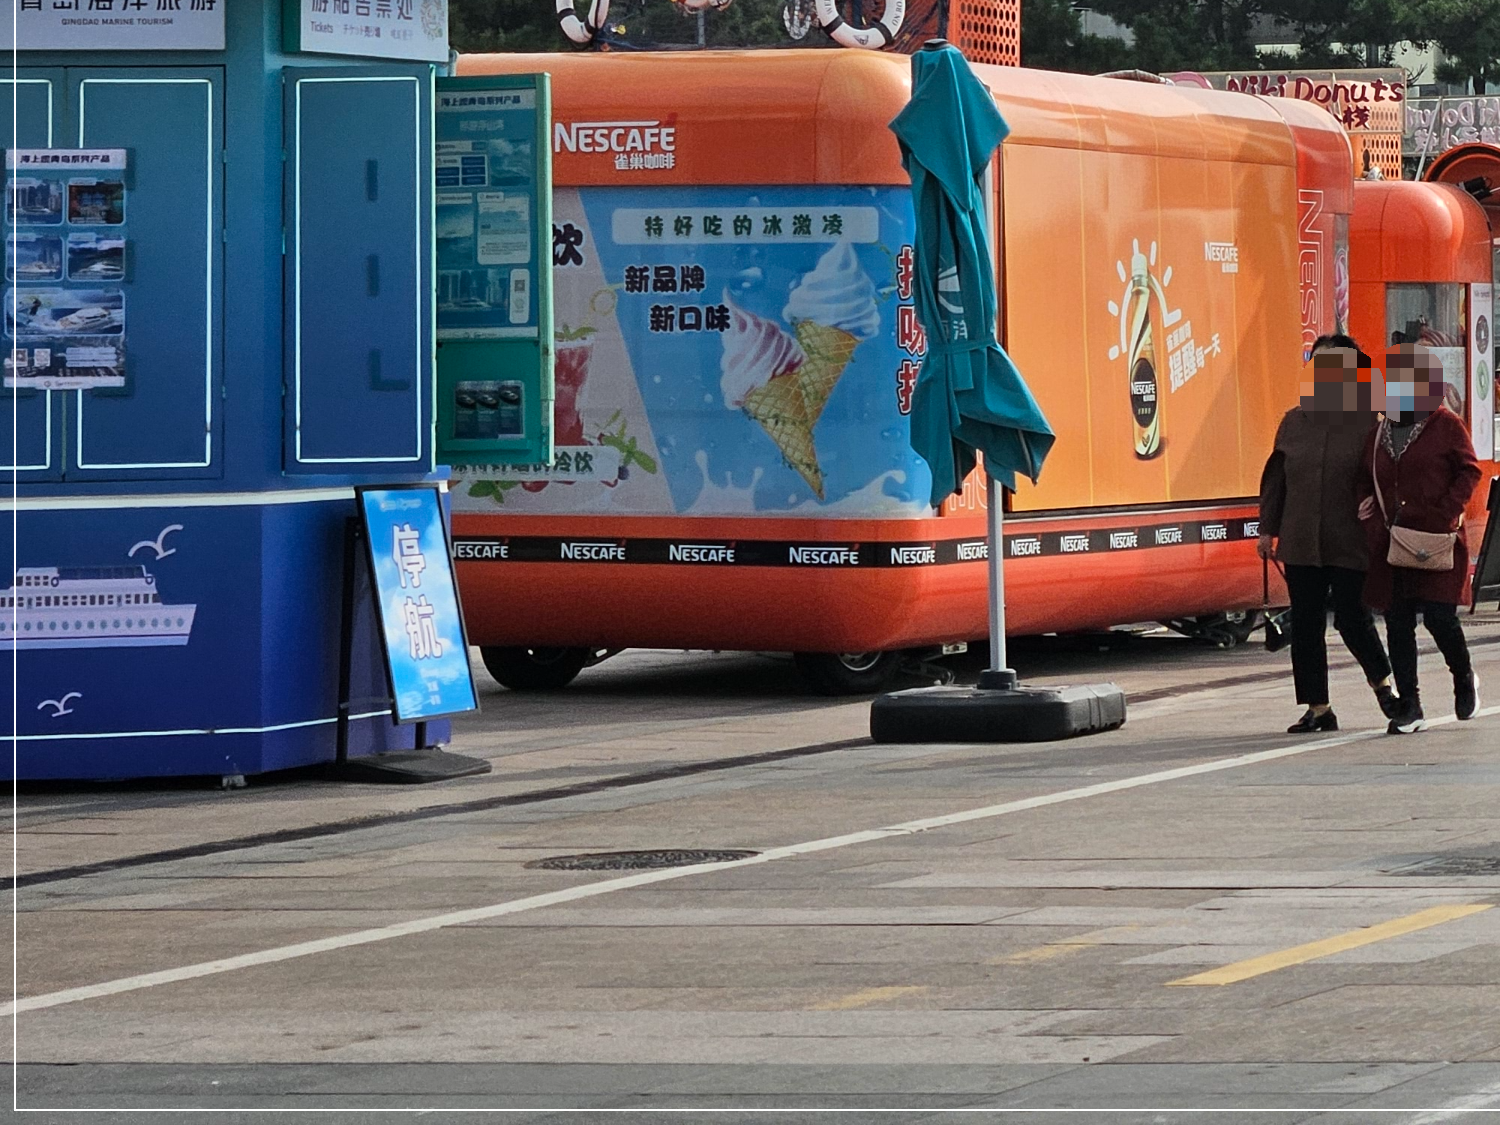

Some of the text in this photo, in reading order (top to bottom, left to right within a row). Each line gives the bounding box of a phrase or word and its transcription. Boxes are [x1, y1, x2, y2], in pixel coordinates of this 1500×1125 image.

[61, 18, 173, 26] QINGDAO MARINE TOURISM
[310, 21, 334, 34] Tickets
[1228, 75, 1405, 104] Niki Donuts
[613, 152, 676, 170] 雀巢咖啡
[643, 215, 846, 237] 特好吃的冰激凌
[624, 265, 706, 294] 新品牌
[649, 305, 731, 333] 新口味
[391, 523, 443, 662] 停航
